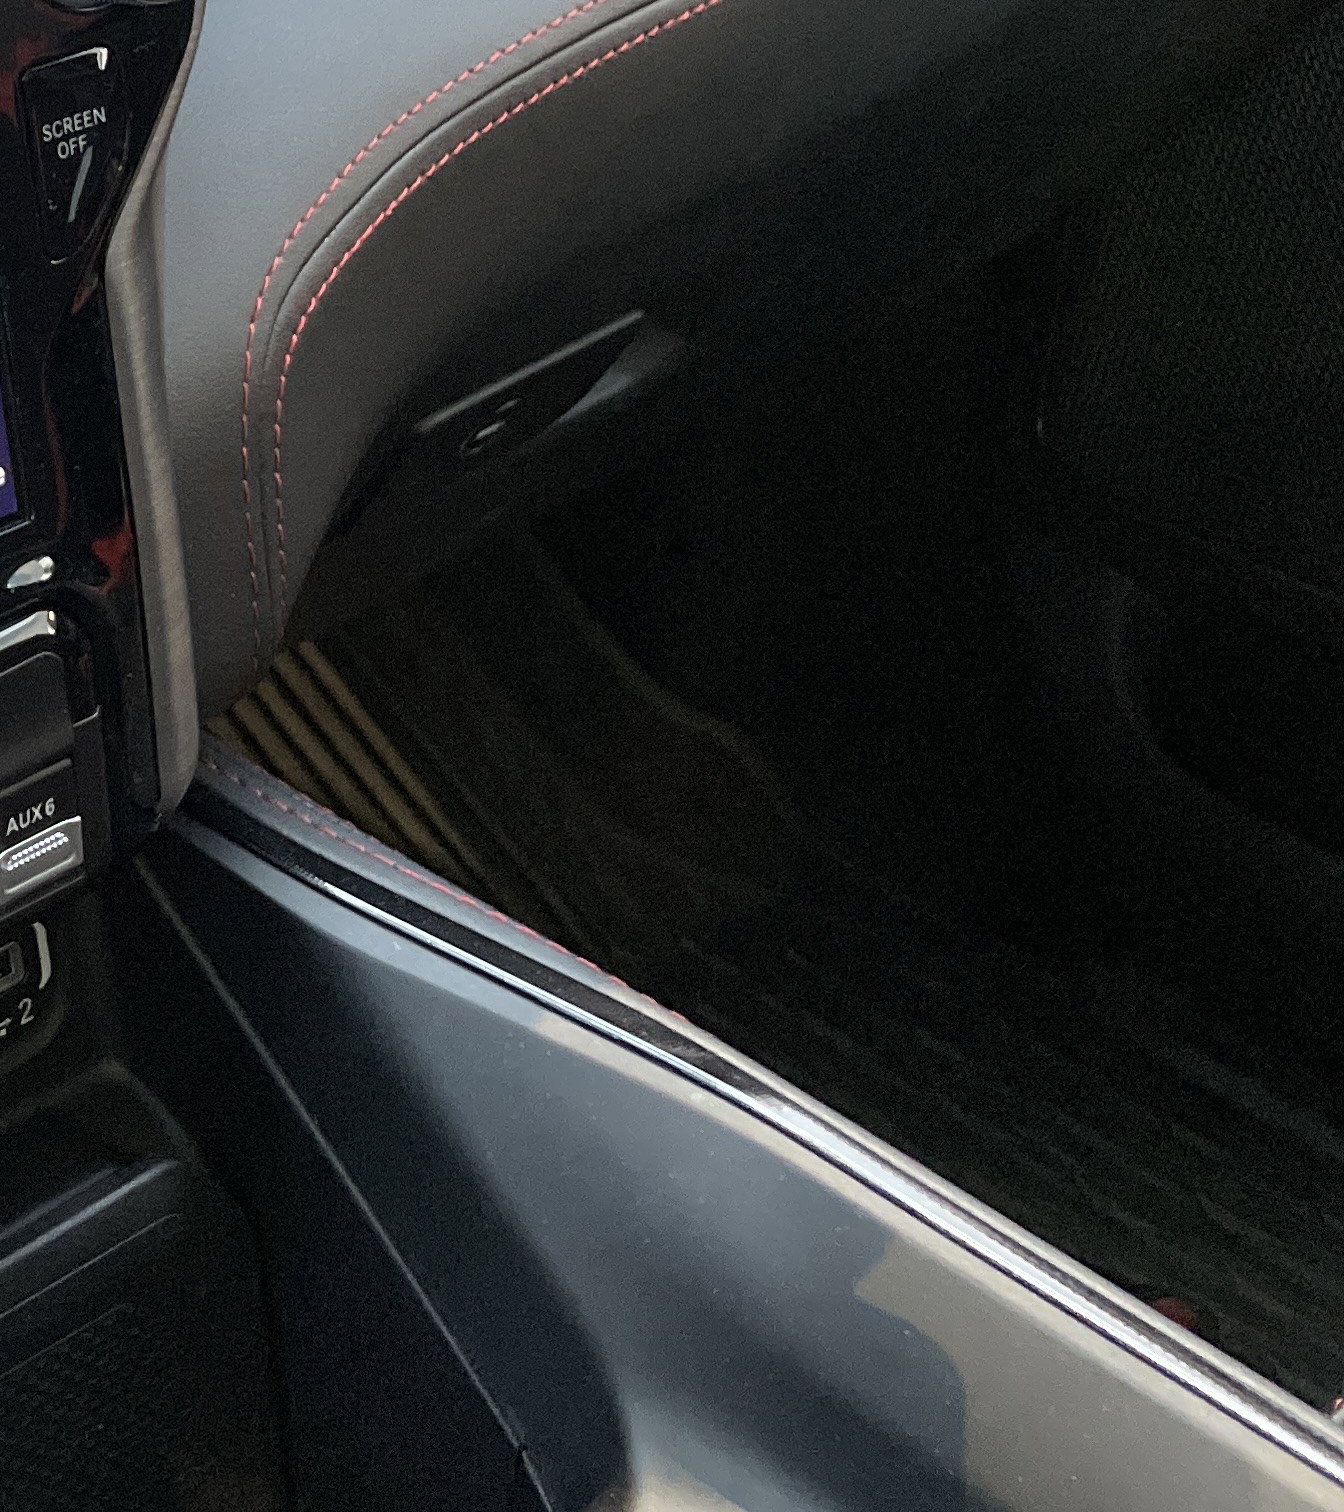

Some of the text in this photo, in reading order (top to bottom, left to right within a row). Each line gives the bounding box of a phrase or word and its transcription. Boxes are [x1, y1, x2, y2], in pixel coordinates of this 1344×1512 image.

[42, 106, 107, 143] SCREEN
[58, 133, 87, 159] OFF
[5, 798, 55, 835] AUX 6
[19, 999, 33, 1026] 2
